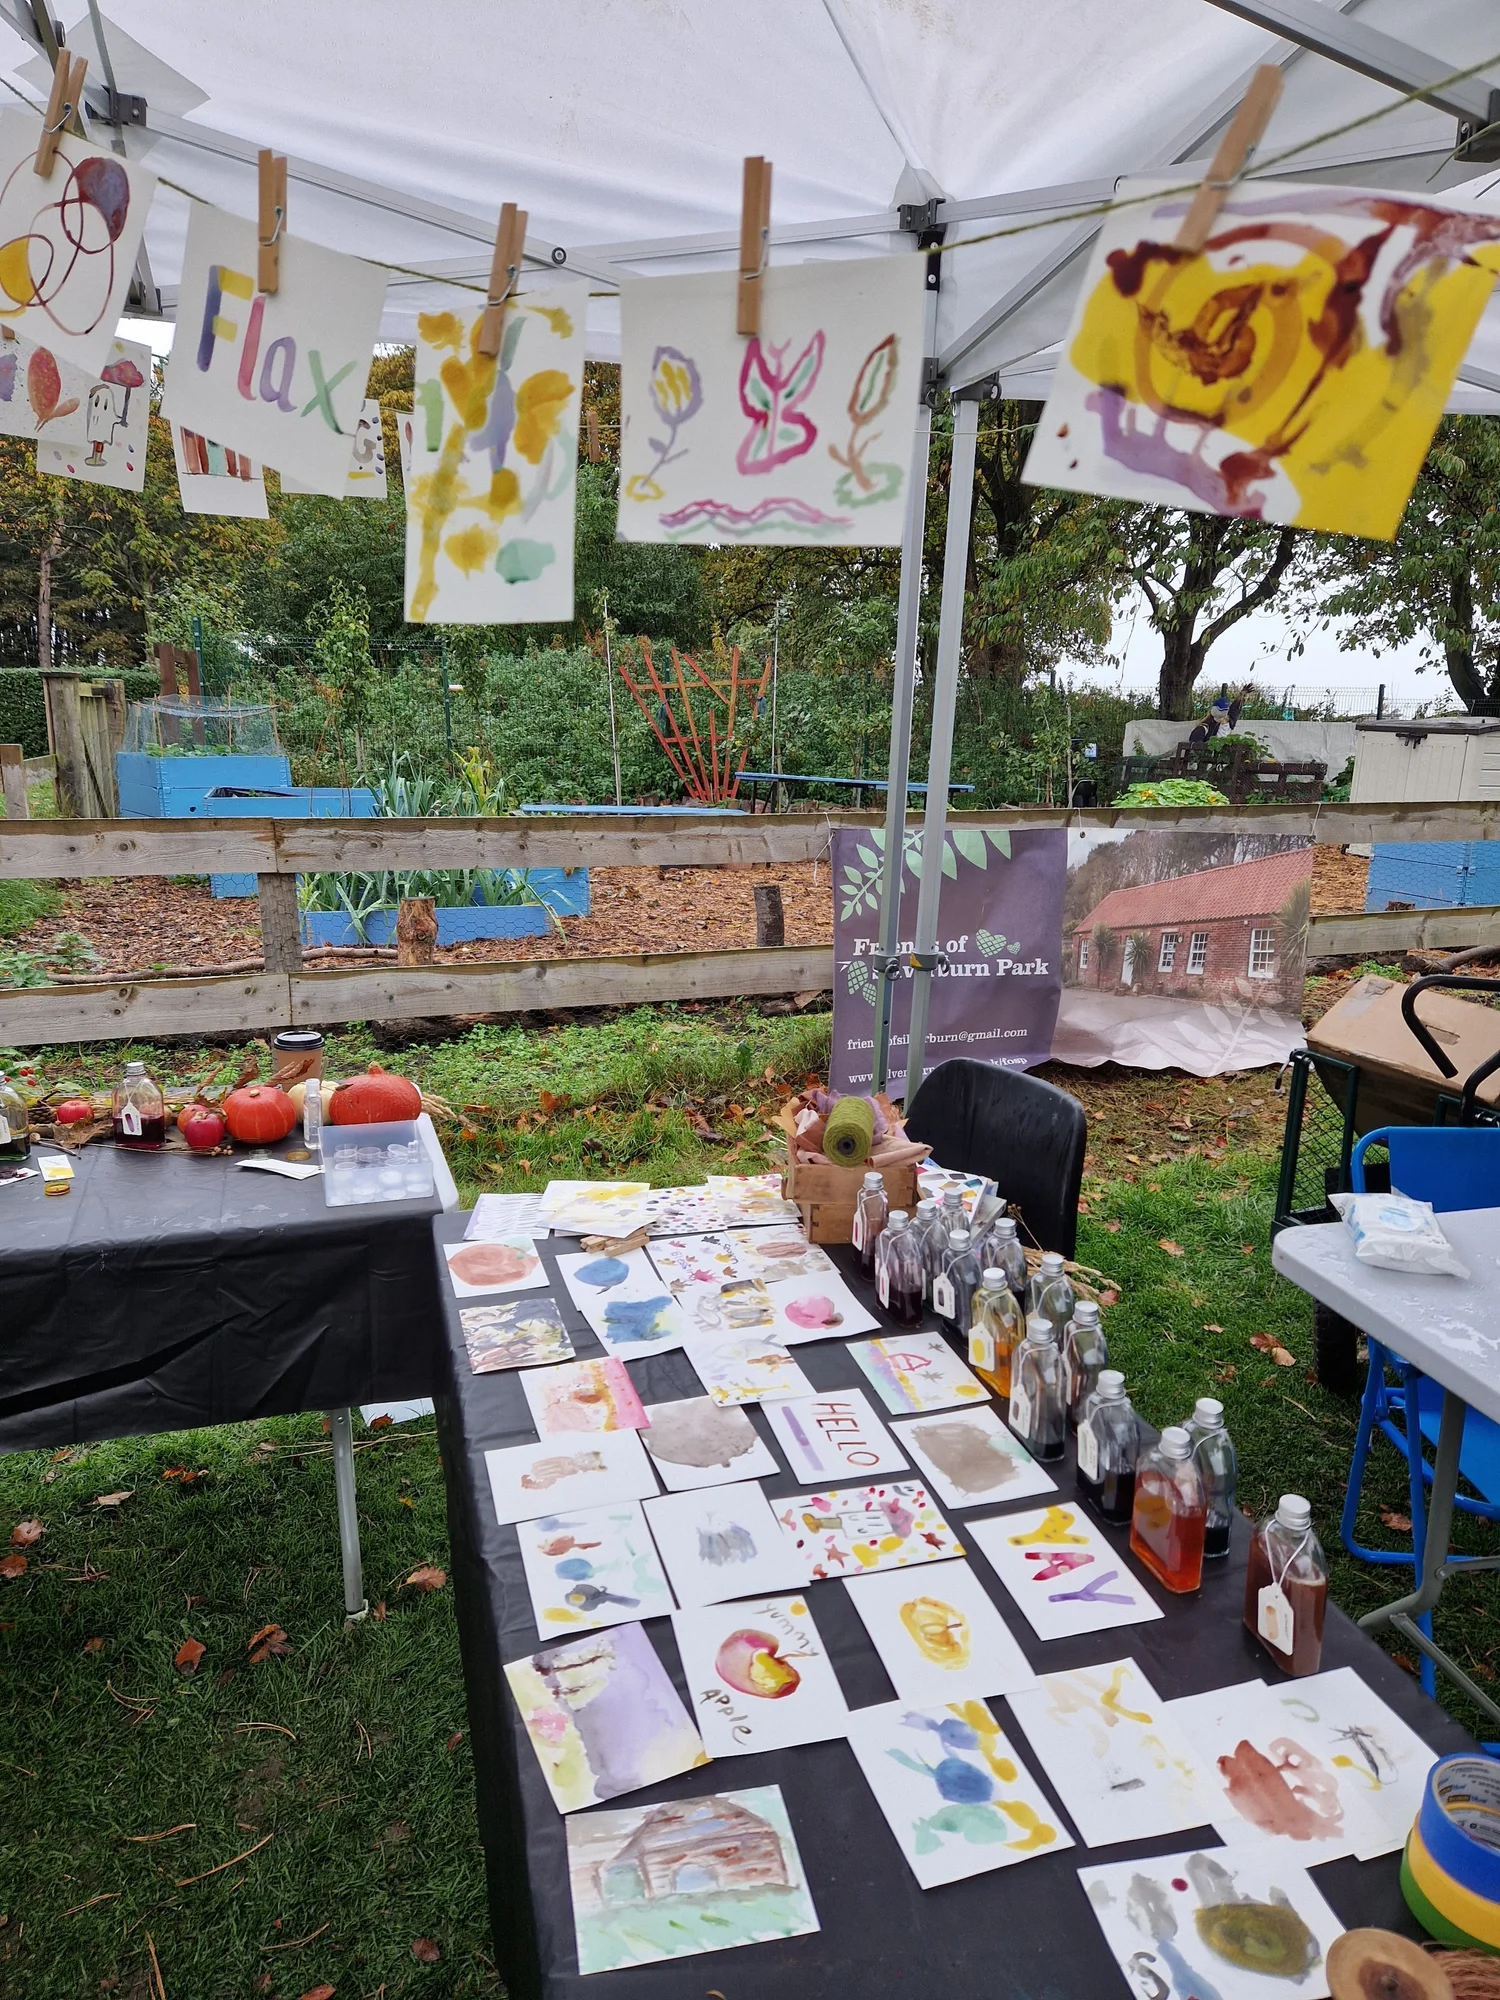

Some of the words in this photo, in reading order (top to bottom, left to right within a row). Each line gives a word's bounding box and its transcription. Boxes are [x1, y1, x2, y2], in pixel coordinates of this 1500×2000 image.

[197, 264, 357, 436] Flax
[945, 935, 969, 954] of
[996, 958, 1050, 977] Park
[811, 1402, 881, 1467] HELLO
[1006, 1505, 1137, 1606] YAY
